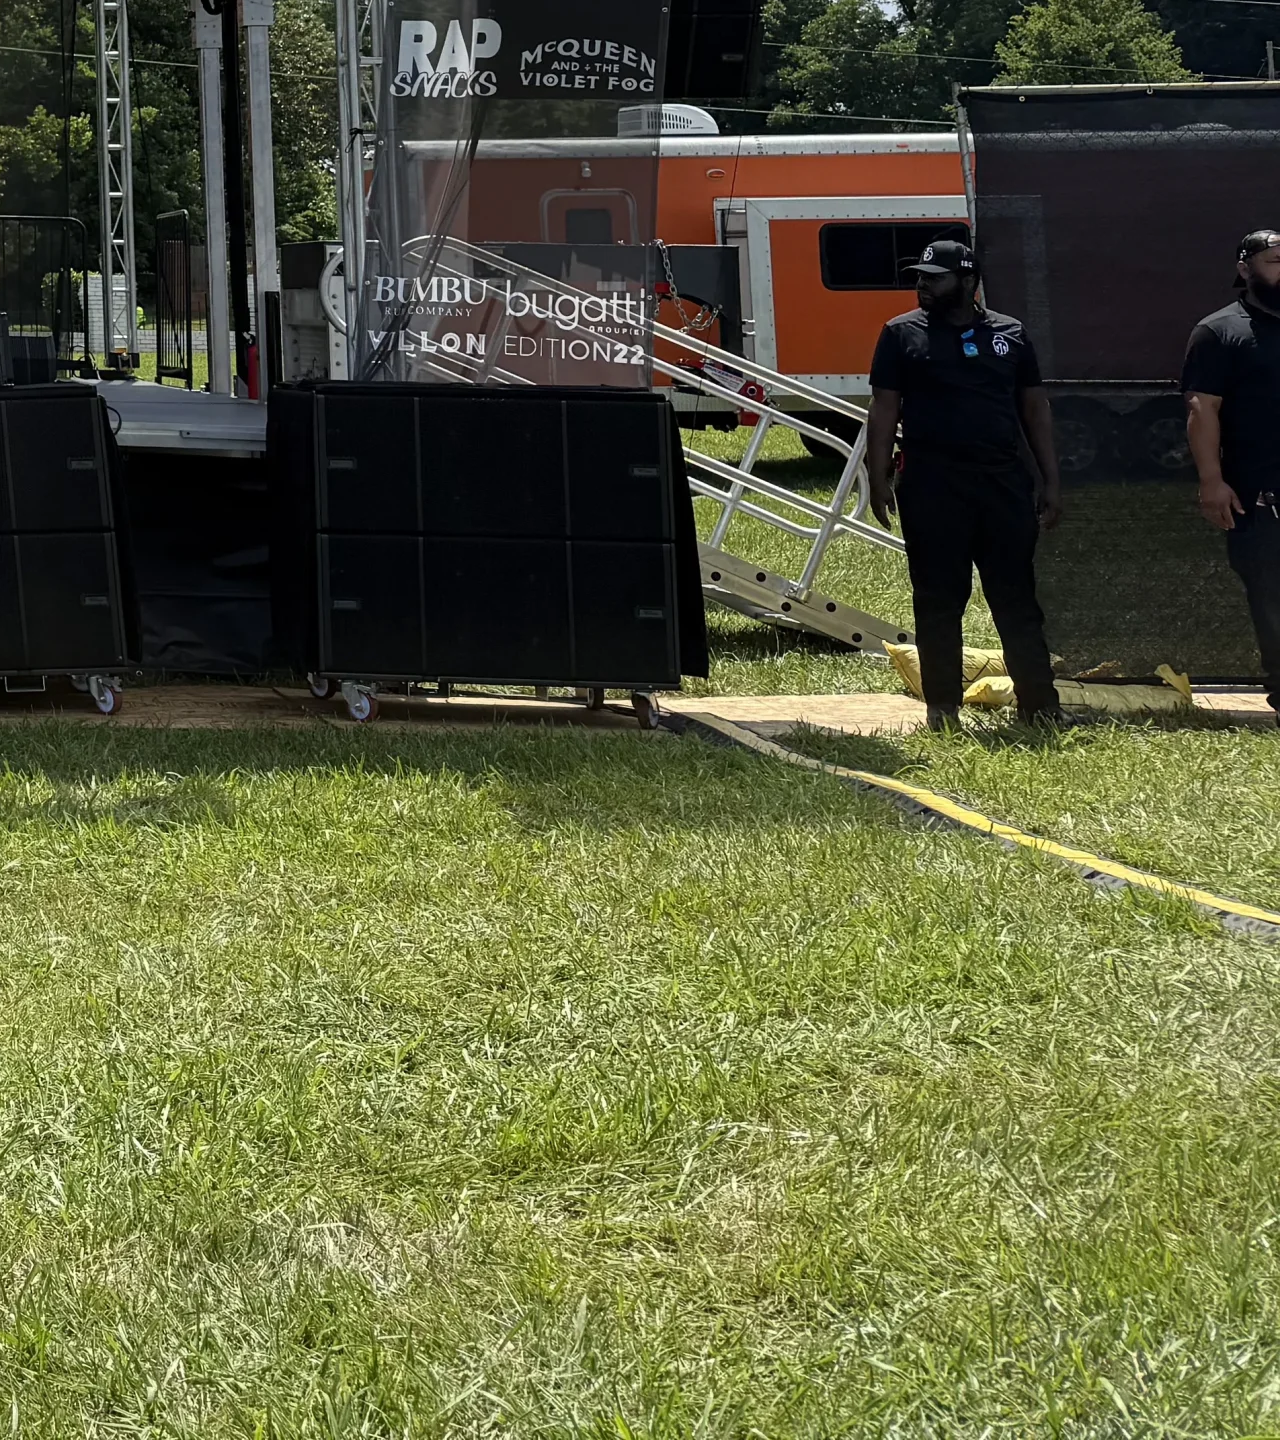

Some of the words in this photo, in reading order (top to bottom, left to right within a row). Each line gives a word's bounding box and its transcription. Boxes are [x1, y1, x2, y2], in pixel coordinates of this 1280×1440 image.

[397, 19, 502, 78] RAP
[520, 72, 600, 89] VIOLET
[608, 76, 655, 92] FOG
[551, 61, 580, 71] AND
[595, 63, 620, 73] THE
[372, 275, 490, 305] BUMBU
[505, 279, 645, 331] bugatti
[384, 305, 407, 317] RU
[407, 305, 473, 317] COMPANY
[504, 335, 645, 365] EDITION22
